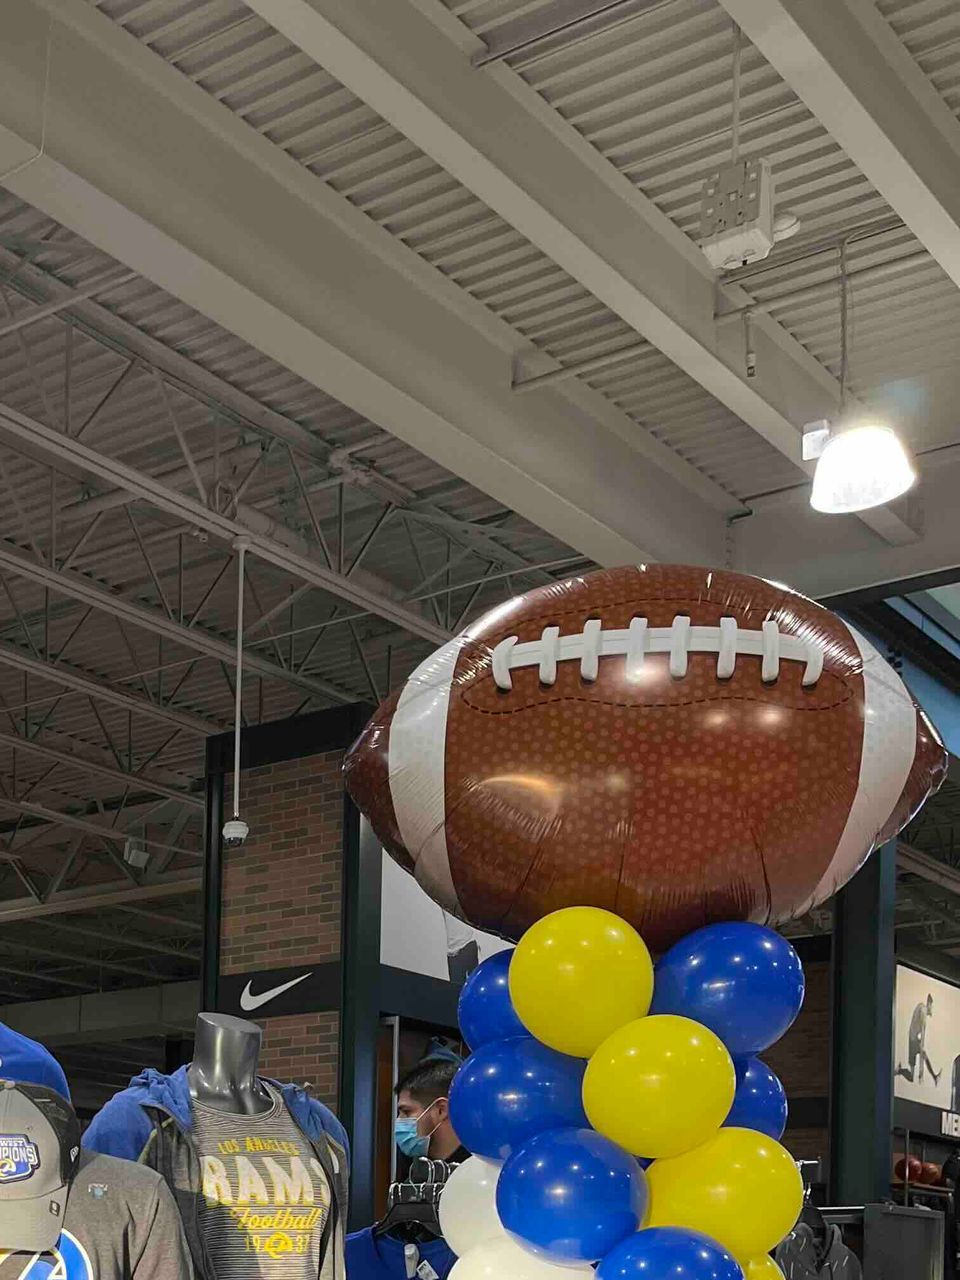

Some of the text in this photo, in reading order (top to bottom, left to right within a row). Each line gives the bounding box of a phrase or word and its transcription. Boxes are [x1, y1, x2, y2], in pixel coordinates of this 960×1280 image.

[0, 1139, 24, 1147] WEST
[218, 1140, 240, 1154] LOS
[231, 1208, 322, 1229] Football
